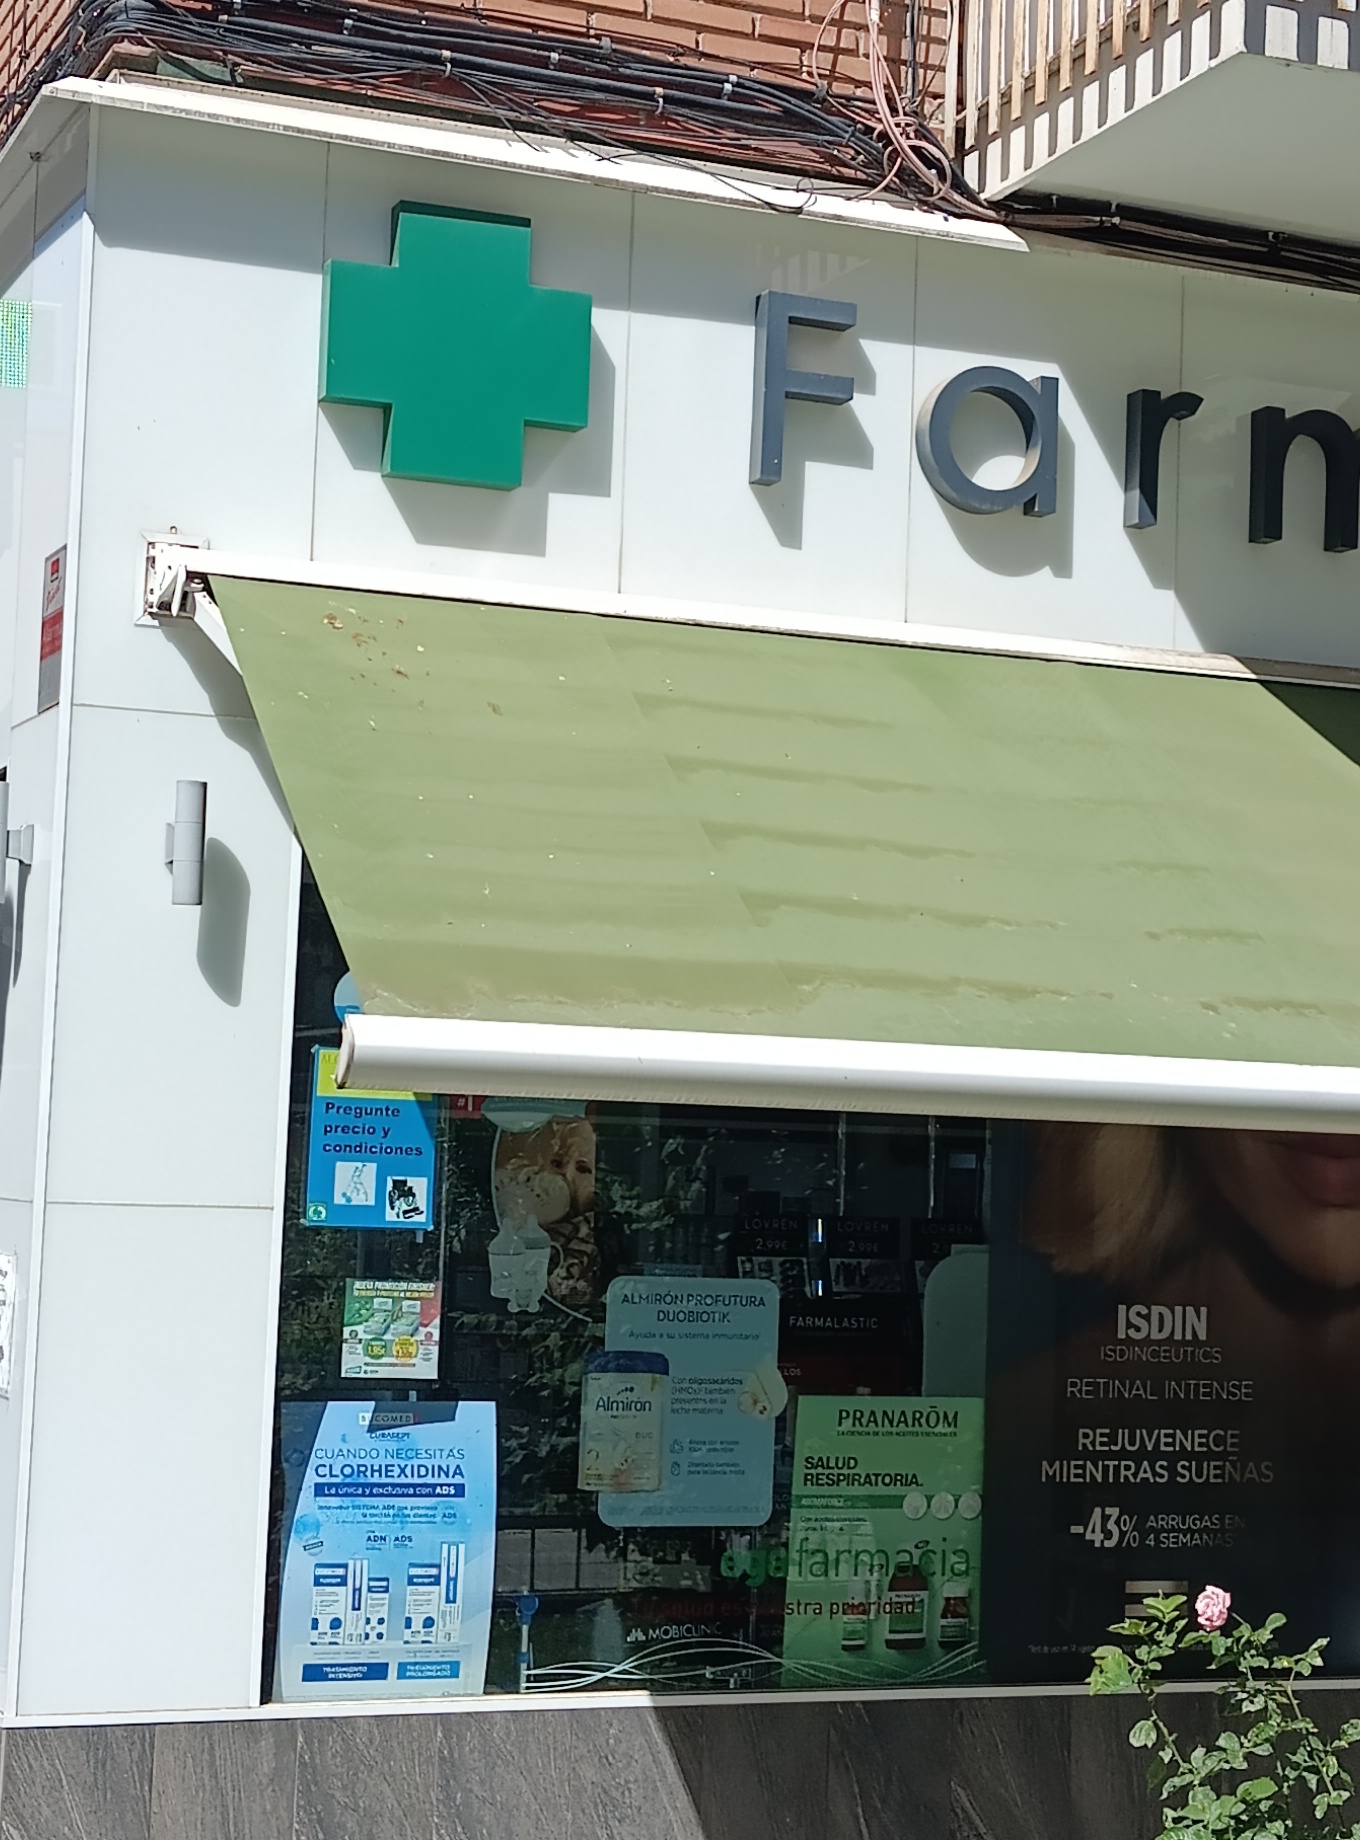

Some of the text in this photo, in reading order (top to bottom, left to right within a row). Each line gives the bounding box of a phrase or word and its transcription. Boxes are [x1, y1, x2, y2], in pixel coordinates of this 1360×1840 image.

[325, 1102, 401, 1118] Pregunte
[323, 1123, 391, 1139] precio y
[322, 1142, 423, 1156] condiciones
[744, 1218, 798, 1230] LOVREN
[837, 1221, 889, 1233] LOVREN
[922, 1223, 973, 1234] LOVREN
[621, 1291, 766, 1307] ALMIRÓN PROFUTURA
[656, 1310, 731, 1323] DUOBIOTIK
[789, 1316, 879, 1329] FARMALASTIC
[1117, 1304, 1207, 1341] ISDIN
[1100, 1346, 1222, 1363] ISDINCEUTICS
[1066, 1378, 1254, 1401] RETINAL INTENSE
[595, 1396, 652, 1412] Almirón
[1078, 1428, 1240, 1452] REJUVENECE
[314, 1448, 380, 1460] CUANDO
[803, 1456, 859, 1470] SALUD
[1041, 1456, 1275, 1483] MIENTRAS SUEÑAS
[314, 1464, 465, 1479] CLORHEXIDINA
[803, 1473, 924, 1487] RESPIRATORIA.
[324, 1486, 337, 1494] La
[338, 1485, 363, 1494] única
[364, 1487, 371, 1496] y
[372, 1485, 414, 1495] exclusiva
[435, 1486, 456, 1495] ADS
[1070, 1506, 1139, 1548] -43%
[1145, 1514, 1245, 1530] ARRUGAS EN
[366, 1535, 413, 1543] ADN ADS
[1145, 1533, 1155, 1547] 4
[829, 1598, 916, 1619] prioridad
[648, 1622, 722, 1640] MOBICLINIC
